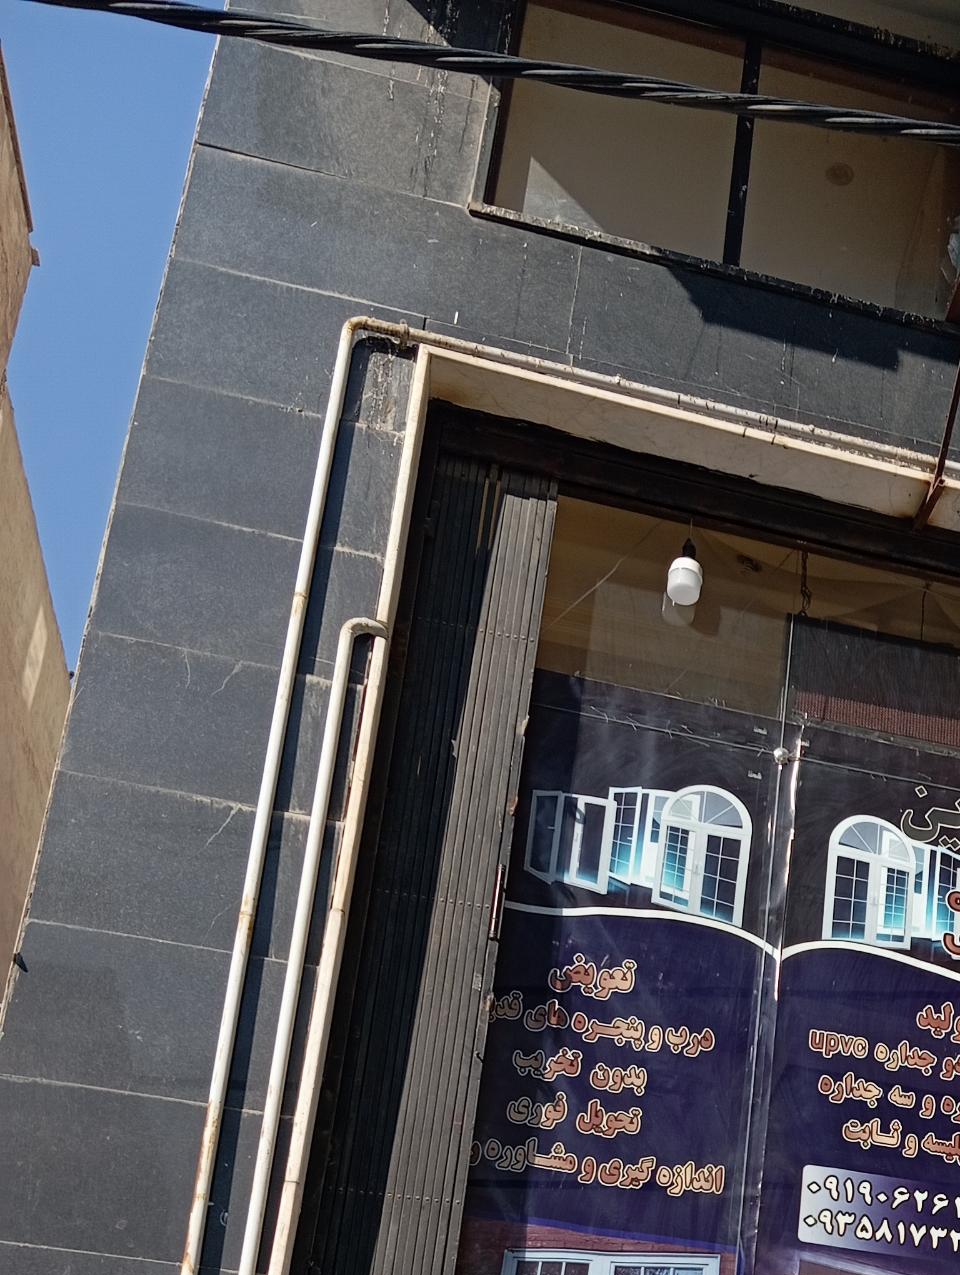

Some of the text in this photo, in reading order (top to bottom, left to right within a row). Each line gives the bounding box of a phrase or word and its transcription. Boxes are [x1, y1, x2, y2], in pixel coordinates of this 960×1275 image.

[548, 953, 637, 1000] تعویض
[524, 999, 569, 1031] های
[571, 1012, 645, 1051] پنجره
[645, 1026, 662, 1050] و
[665, 1026, 715, 1057] درب
[809, 1029, 868, 1058] upvc
[513, 1048, 647, 1096] بدون تخریب
[874, 1041, 937, 1075] جداره
[818, 1072, 882, 1107] جداره
[888, 1084, 915, 1108] سه
[507, 1092, 642, 1138] تحویل فوری
[920, 1095, 935, 1118] و
[842, 1118, 901, 1149] ثابت
[904, 1134, 919, 1157] و
[484, 1137, 578, 1174] مشاوره
[579, 1157, 596, 1183] و
[599, 1157, 656, 1189] گیری
[656, 1161, 725, 1196] اندازه
